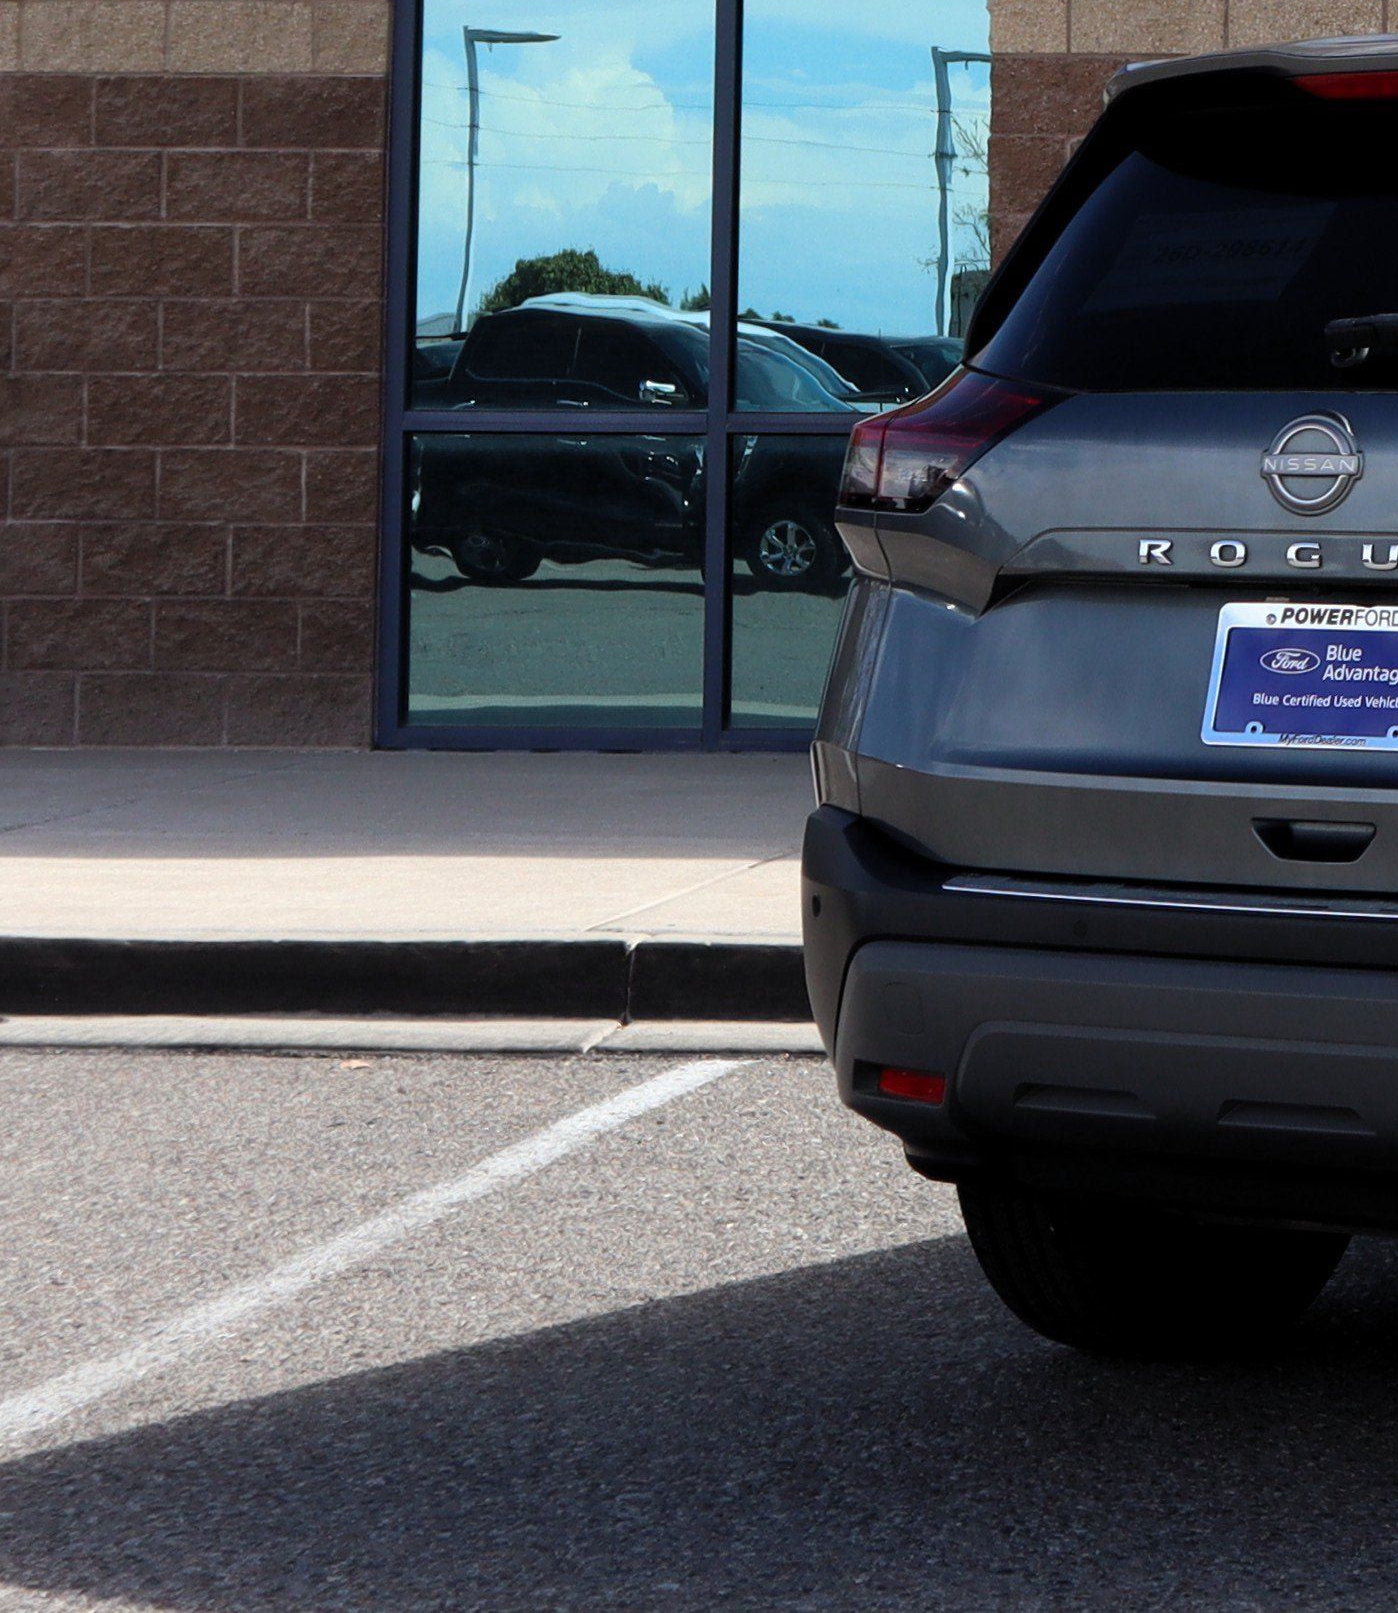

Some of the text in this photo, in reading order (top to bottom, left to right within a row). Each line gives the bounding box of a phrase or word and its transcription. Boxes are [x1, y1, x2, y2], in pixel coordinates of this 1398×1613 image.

[1263, 458, 1355, 472] NISSAN
[1326, 644, 1363, 662] Blue
[1269, 652, 1309, 671] Ford
[1252, 692, 1280, 705] Blue
[1282, 693, 1331, 708] Certified
[1333, 695, 1362, 708] Used
[1278, 732, 1366, 746] MyFordDealer.com
